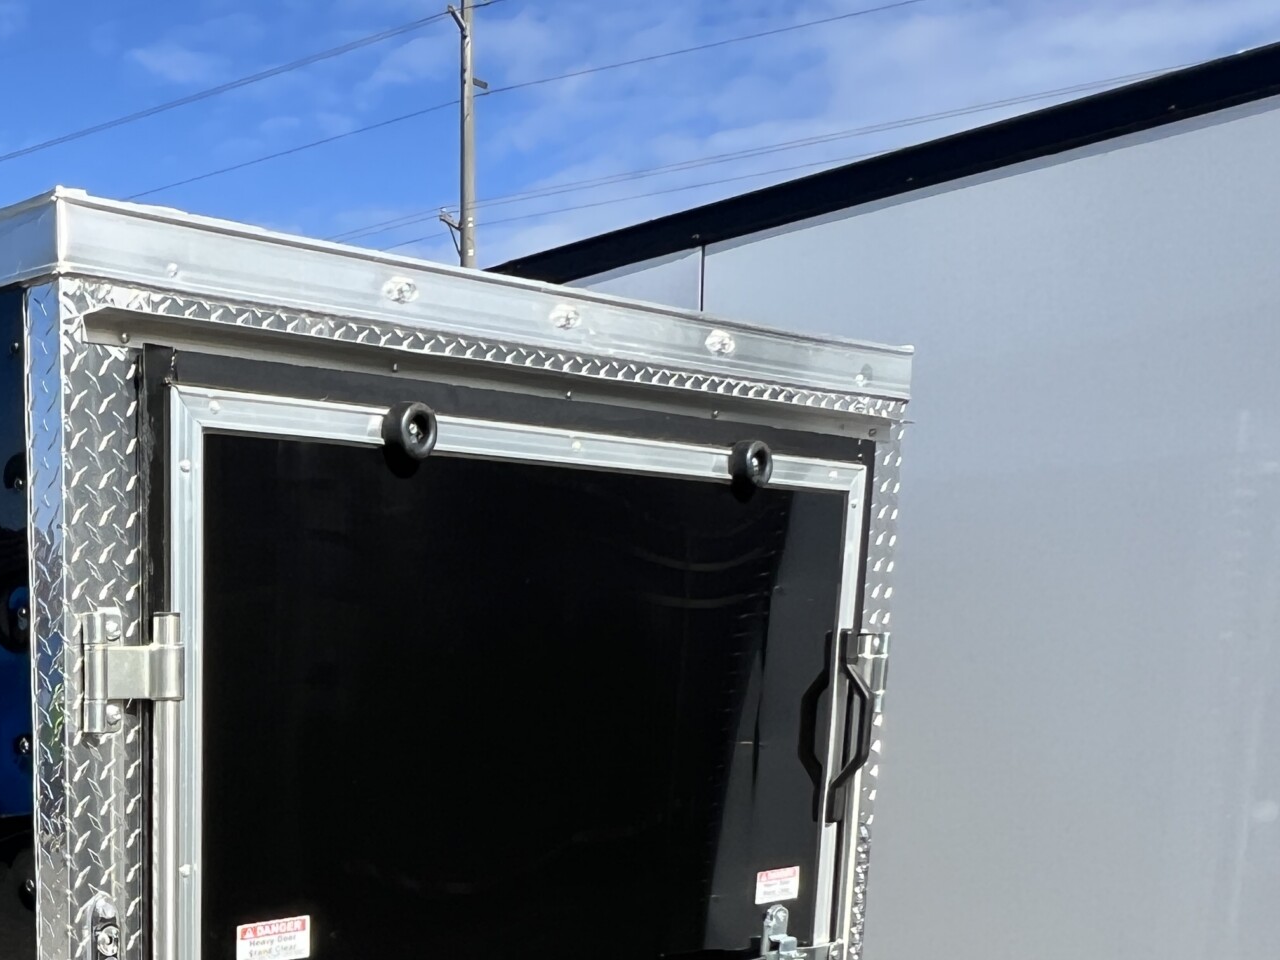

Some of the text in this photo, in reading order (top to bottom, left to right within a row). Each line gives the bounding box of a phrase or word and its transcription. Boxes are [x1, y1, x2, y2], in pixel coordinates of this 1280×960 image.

[256, 920, 302, 935] DANGER
[249, 934, 297, 947] Heavy Door
[248, 948, 272, 958] Stand
[275, 944, 297, 953] Clear
